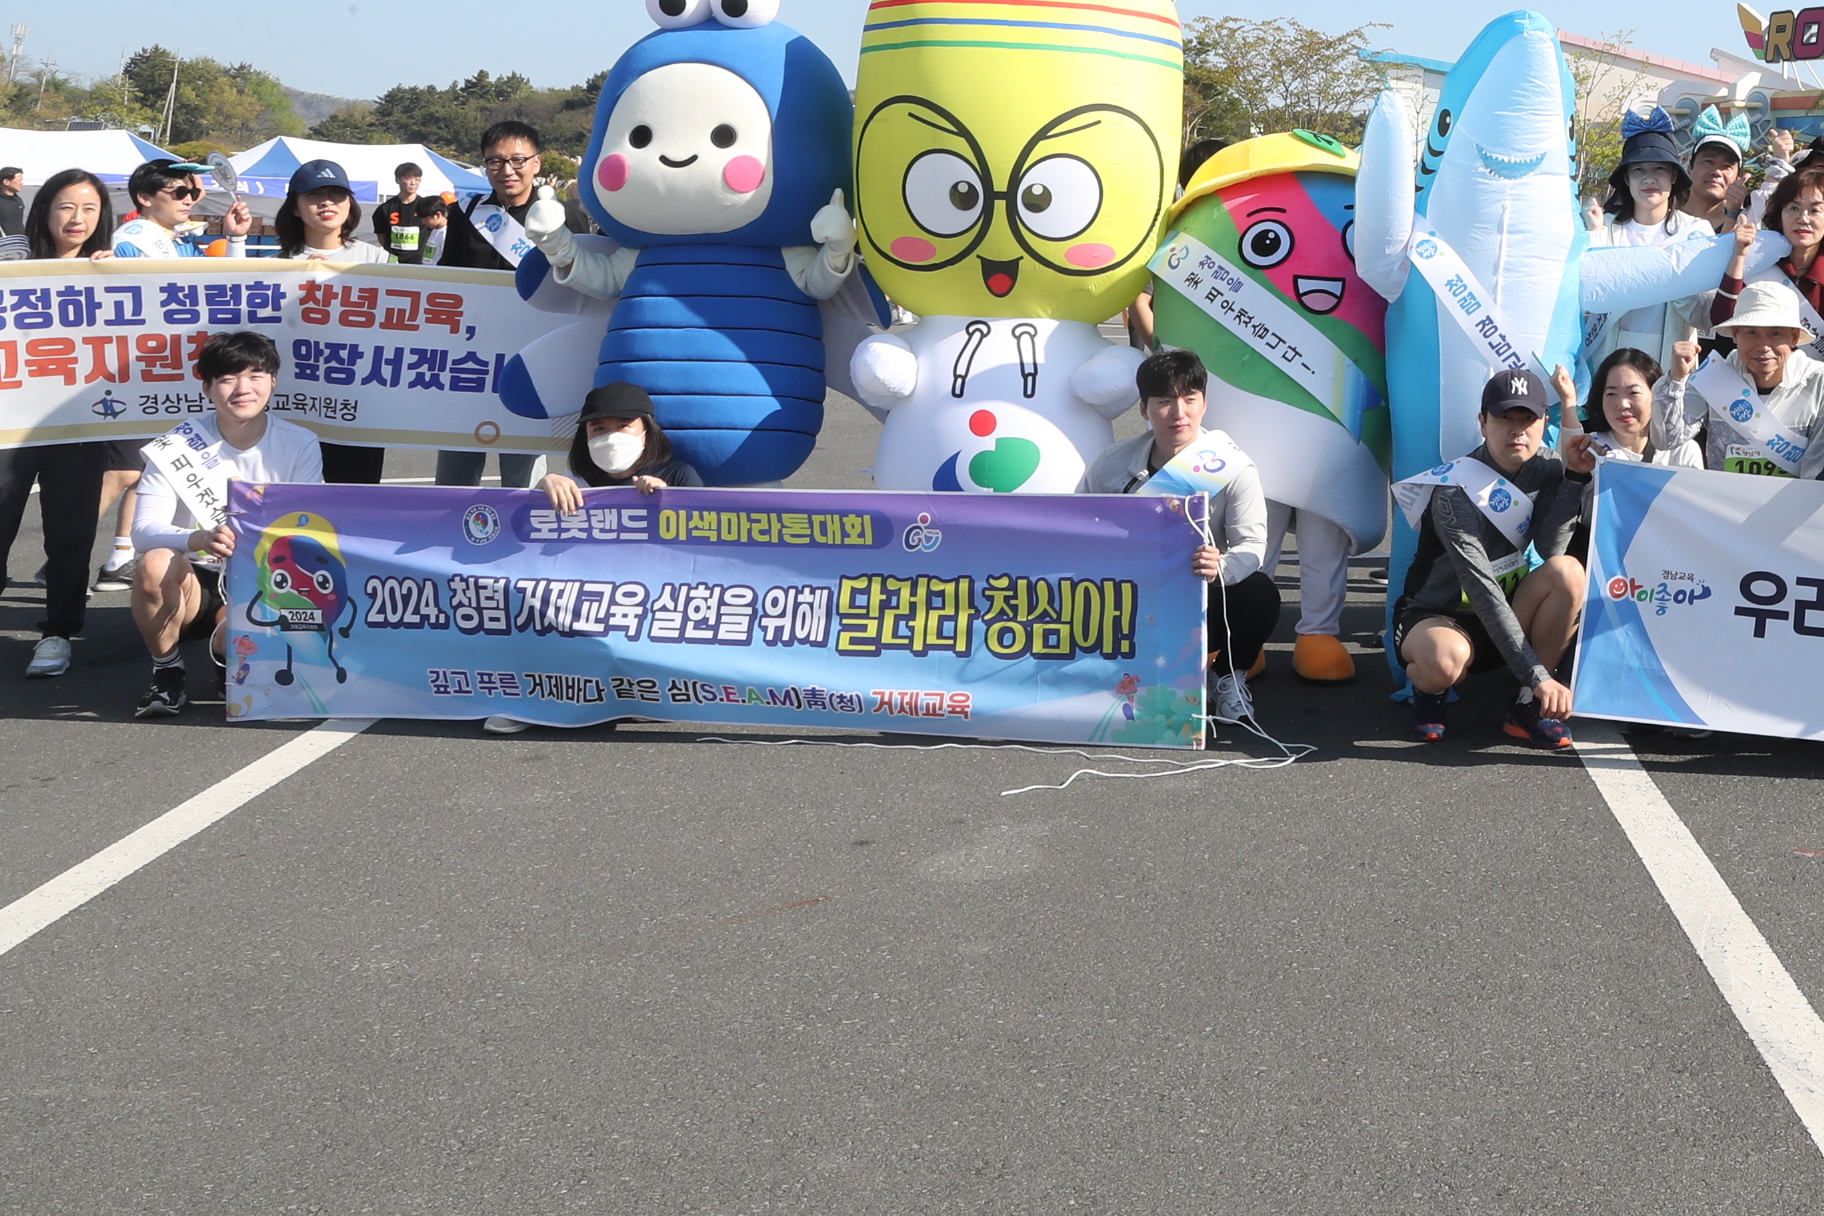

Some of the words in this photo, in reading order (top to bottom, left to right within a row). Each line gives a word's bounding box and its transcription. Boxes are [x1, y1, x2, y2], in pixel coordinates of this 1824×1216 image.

[1198, 254, 1245, 294] 청렴을
[159, 280, 287, 325] 청렴한
[298, 280, 477, 341] 창녕교육,
[1184, 271, 1204, 291] 꽃
[1204, 286, 1316, 375] 피우겠습니다!
[1444, 274, 1482, 316] 청렴
[1475, 315, 1532, 371] 경남교
[529, 508, 649, 541] 로봇랜드
[658, 509, 874, 546] 이색마라톤대회
[1607, 574, 1713, 617] 아이좋아
[1661, 569, 1696, 583] 경남교육
[288, 610, 316, 622] 2024
[364, 577, 448, 626] 2024.
[448, 574, 508, 632] 청렴
[515, 578, 646, 638] 거제교육
[650, 583, 755, 641] 실현을
[760, 586, 831, 643] 위해
[836, 575, 977, 652] 달려라
[982, 575, 1133, 655] 청심아!
[428, 668, 474, 696] 깊고
[477, 670, 521, 698] 푸른
[523, 672, 606, 705] 거제바다
[609, 676, 660, 704] 같은
[871, 689, 972, 721] 거제교육
